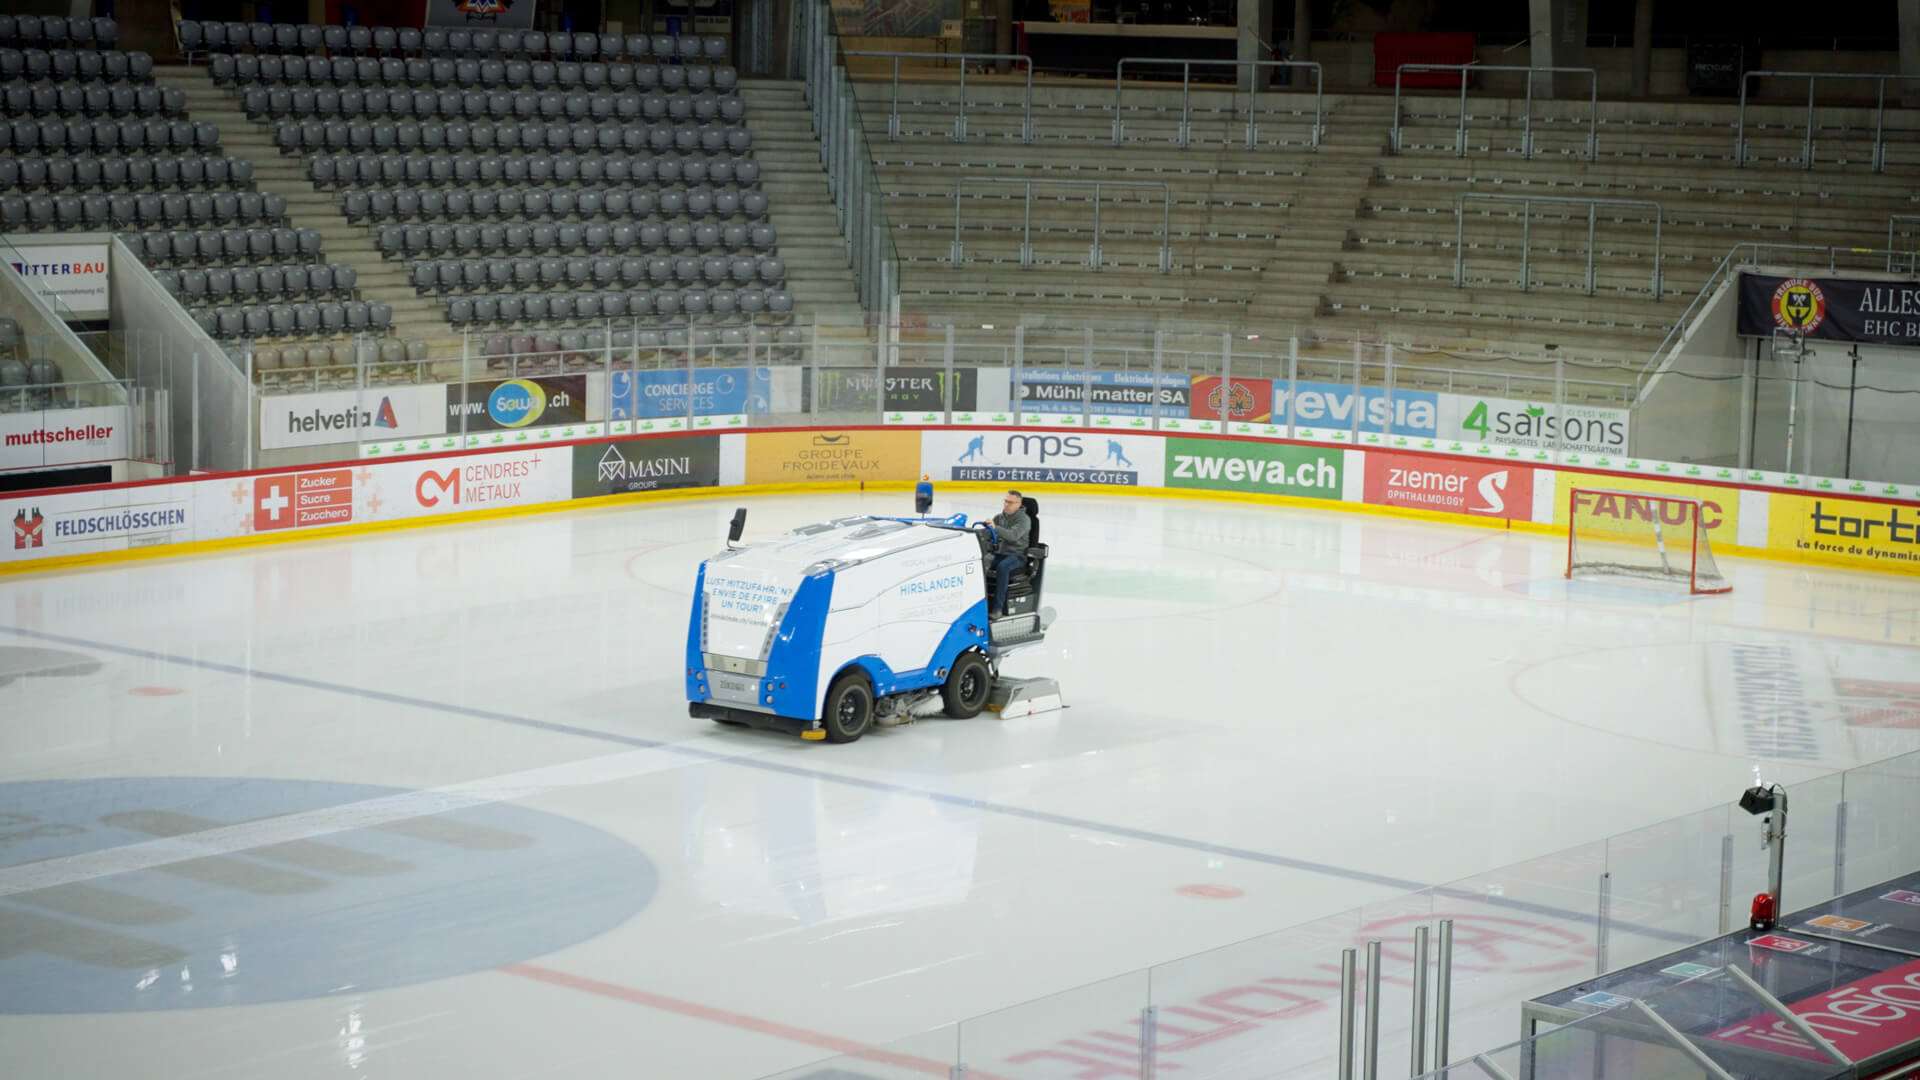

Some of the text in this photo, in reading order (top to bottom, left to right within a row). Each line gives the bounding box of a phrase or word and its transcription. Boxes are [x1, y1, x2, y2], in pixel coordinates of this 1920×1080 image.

[1859, 288, 1920, 316] ALLES
[1864, 320, 1901, 337] EHC
[644, 382, 715, 397] CONCIERGE
[1160, 389, 1186, 404] SA
[449, 402, 486, 417] www.
[658, 396, 715, 411] SERVCES
[1274, 388, 1437, 430] revisia
[288, 405, 371, 433] helvetia
[1461, 400, 1626, 446] 4 saisons
[5, 424, 114, 447] muttscheller
[798, 449, 864, 460] GROUPE
[1007, 433, 1084, 464] mps
[629, 456, 691, 479] MASINI
[782, 459, 881, 472] FROIDEVAUX
[1172, 456, 1337, 490] zweva.ch
[300, 476, 337, 489] Zucker
[628, 480, 658, 491] GROUPE
[959, 467, 1130, 486] FIERS D'ÊTRE À VOS CÔTÉS
[300, 494, 331, 505] Sucre
[465, 482, 522, 504] MÉTAUX
[1387, 489, 1465, 507] OPHTHALMOLOGY
[300, 508, 349, 522] Zucchero
[1570, 489, 1724, 530] FANUC
[55, 508, 186, 538] FELDSCHLÖSSCHEN
[1796, 539, 1920, 561] La force du dynamis
[706, 576, 727, 586] LUST
[900, 575, 965, 597] HIRSLANDEN
[712, 587, 779, 605] ENVIE DE FAIRE
[720, 600, 764, 613] UN TOUR?
